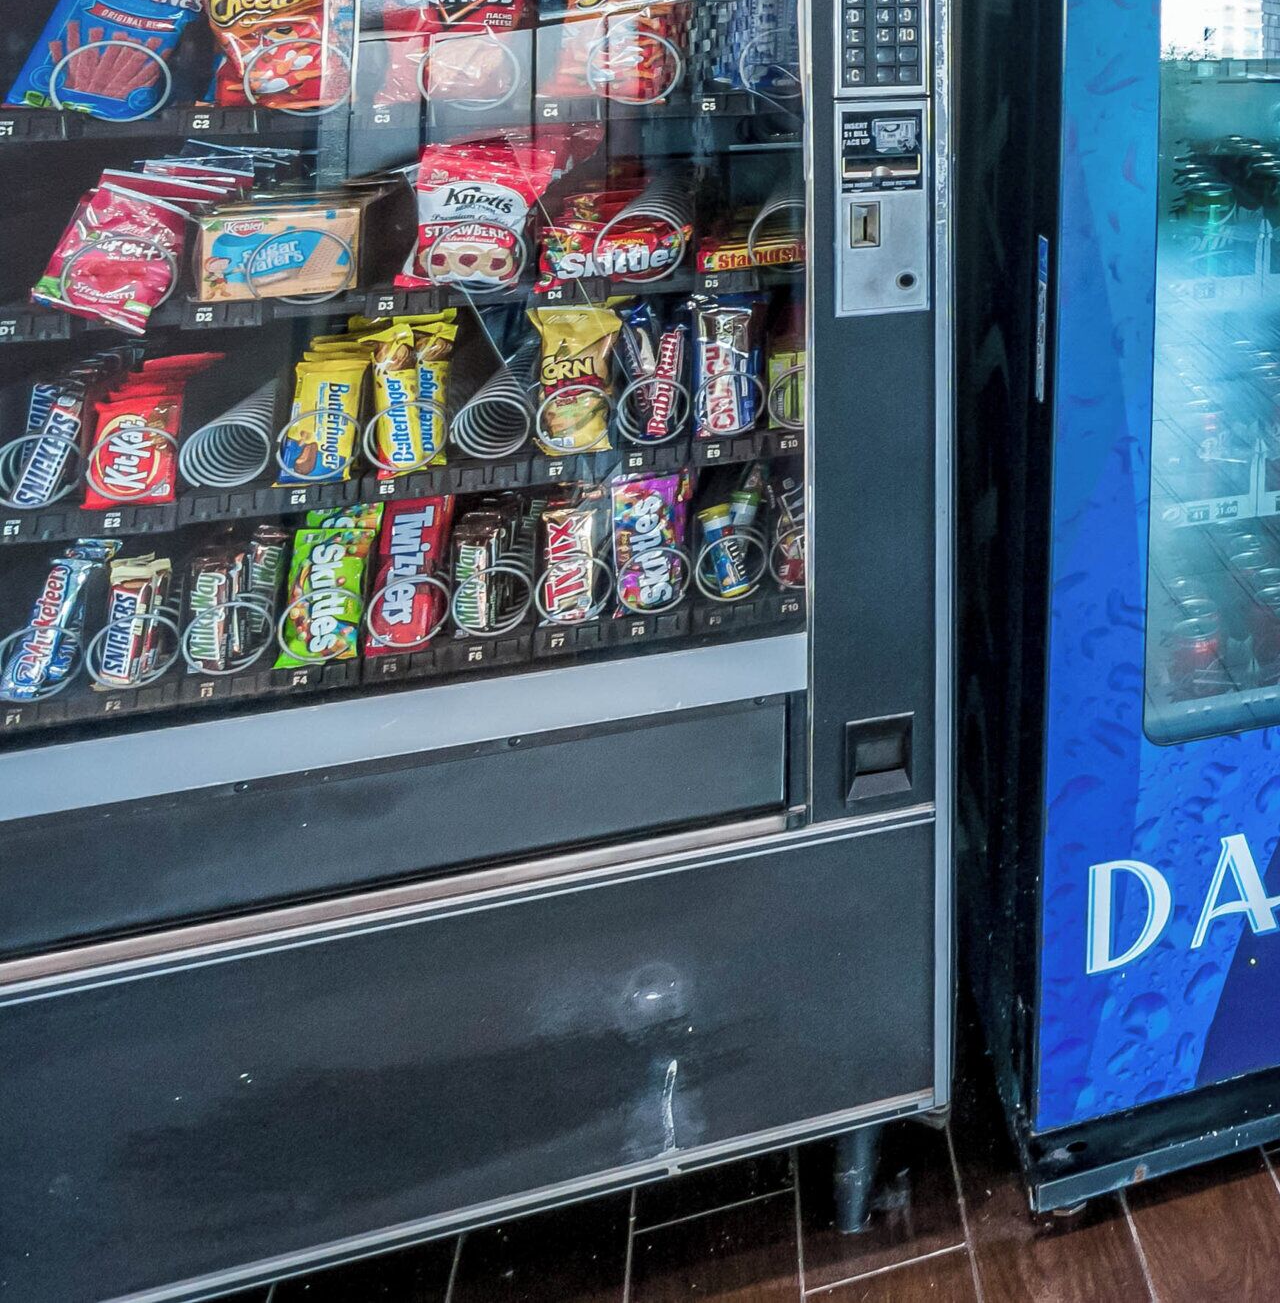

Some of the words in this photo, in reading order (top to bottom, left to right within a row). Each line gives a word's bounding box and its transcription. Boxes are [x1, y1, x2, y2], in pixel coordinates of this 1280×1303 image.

[101, 9, 142, 27] ORIGINAL
[851, 10, 859, 22] D
[881, 10, 889, 22] 4
[904, 10, 911, 21] 9
[851, 30, 859, 42] E
[882, 30, 889, 41] 5
[902, 29, 914, 40] 10
[544, 108, 558, 117] C4
[375, 113, 390, 123] C3
[192, 119, 210, 129] C2
[0, 124, 13, 136] C1
[443, 187, 513, 214] Knott's
[431, 214, 476, 222] Premium
[225, 221, 264, 235] Keebler
[705, 280, 719, 288] D5
[548, 291, 562, 299] D4
[378, 301, 393, 311] D3
[196, 313, 213, 322] D2
[0, 323, 15, 334] D1
[541, 355, 594, 384] CORN
[320, 382, 350, 469] Butterfinger
[387, 378, 415, 463] Butterfinger
[780, 439, 798, 449] E10
[15, 411, 79, 505] SNICKERS
[707, 449, 721, 458] E9
[629, 457, 643, 467] E8
[549, 466, 563, 476] E7
[379, 485, 395, 494] E5
[291, 495, 306, 504] E4
[104, 518, 121, 528] E2
[4, 526, 19, 535] E1
[629, 495, 672, 604] Skittles
[309, 543, 347, 652] Skittles
[781, 604, 799, 612] F10
[104, 592, 138, 675] SNICKERS
[631, 626, 645, 636] F8
[551, 638, 565, 647] F7
[468, 652, 483, 661] F6
[382, 664, 397, 673] F5
[293, 676, 308, 686] F4
[201, 688, 213, 697] F3
[105, 701, 121, 711] F2
[6, 715, 21, 724] F1
